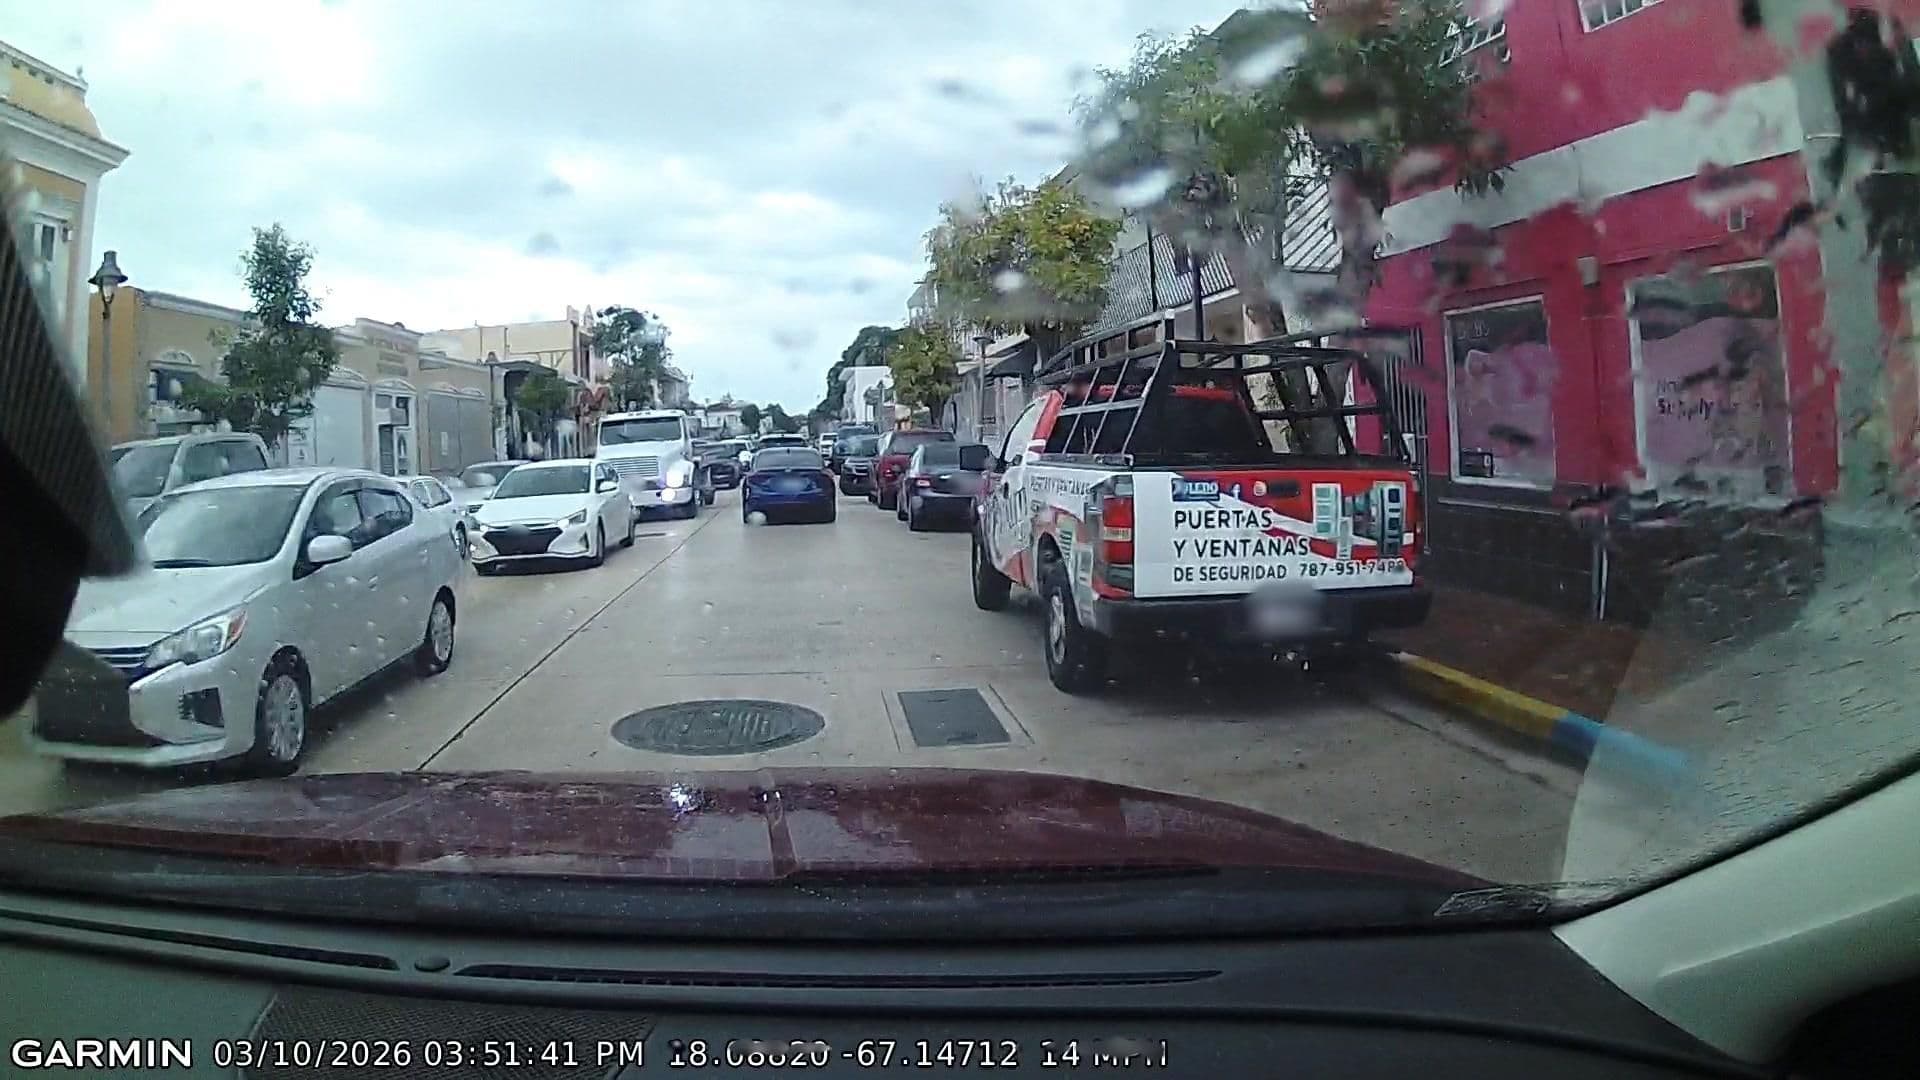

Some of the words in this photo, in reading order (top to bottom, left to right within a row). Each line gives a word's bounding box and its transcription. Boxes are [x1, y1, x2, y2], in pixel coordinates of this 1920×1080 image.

[1173, 480, 1218, 495] LEDO
[1174, 509, 1273, 530] PUERTAS
[1173, 540, 1187, 558] Y
[1194, 537, 1309, 558] VENTANAS
[1174, 566, 1193, 582] DE
[1199, 564, 1287, 582] SEGURIDAD
